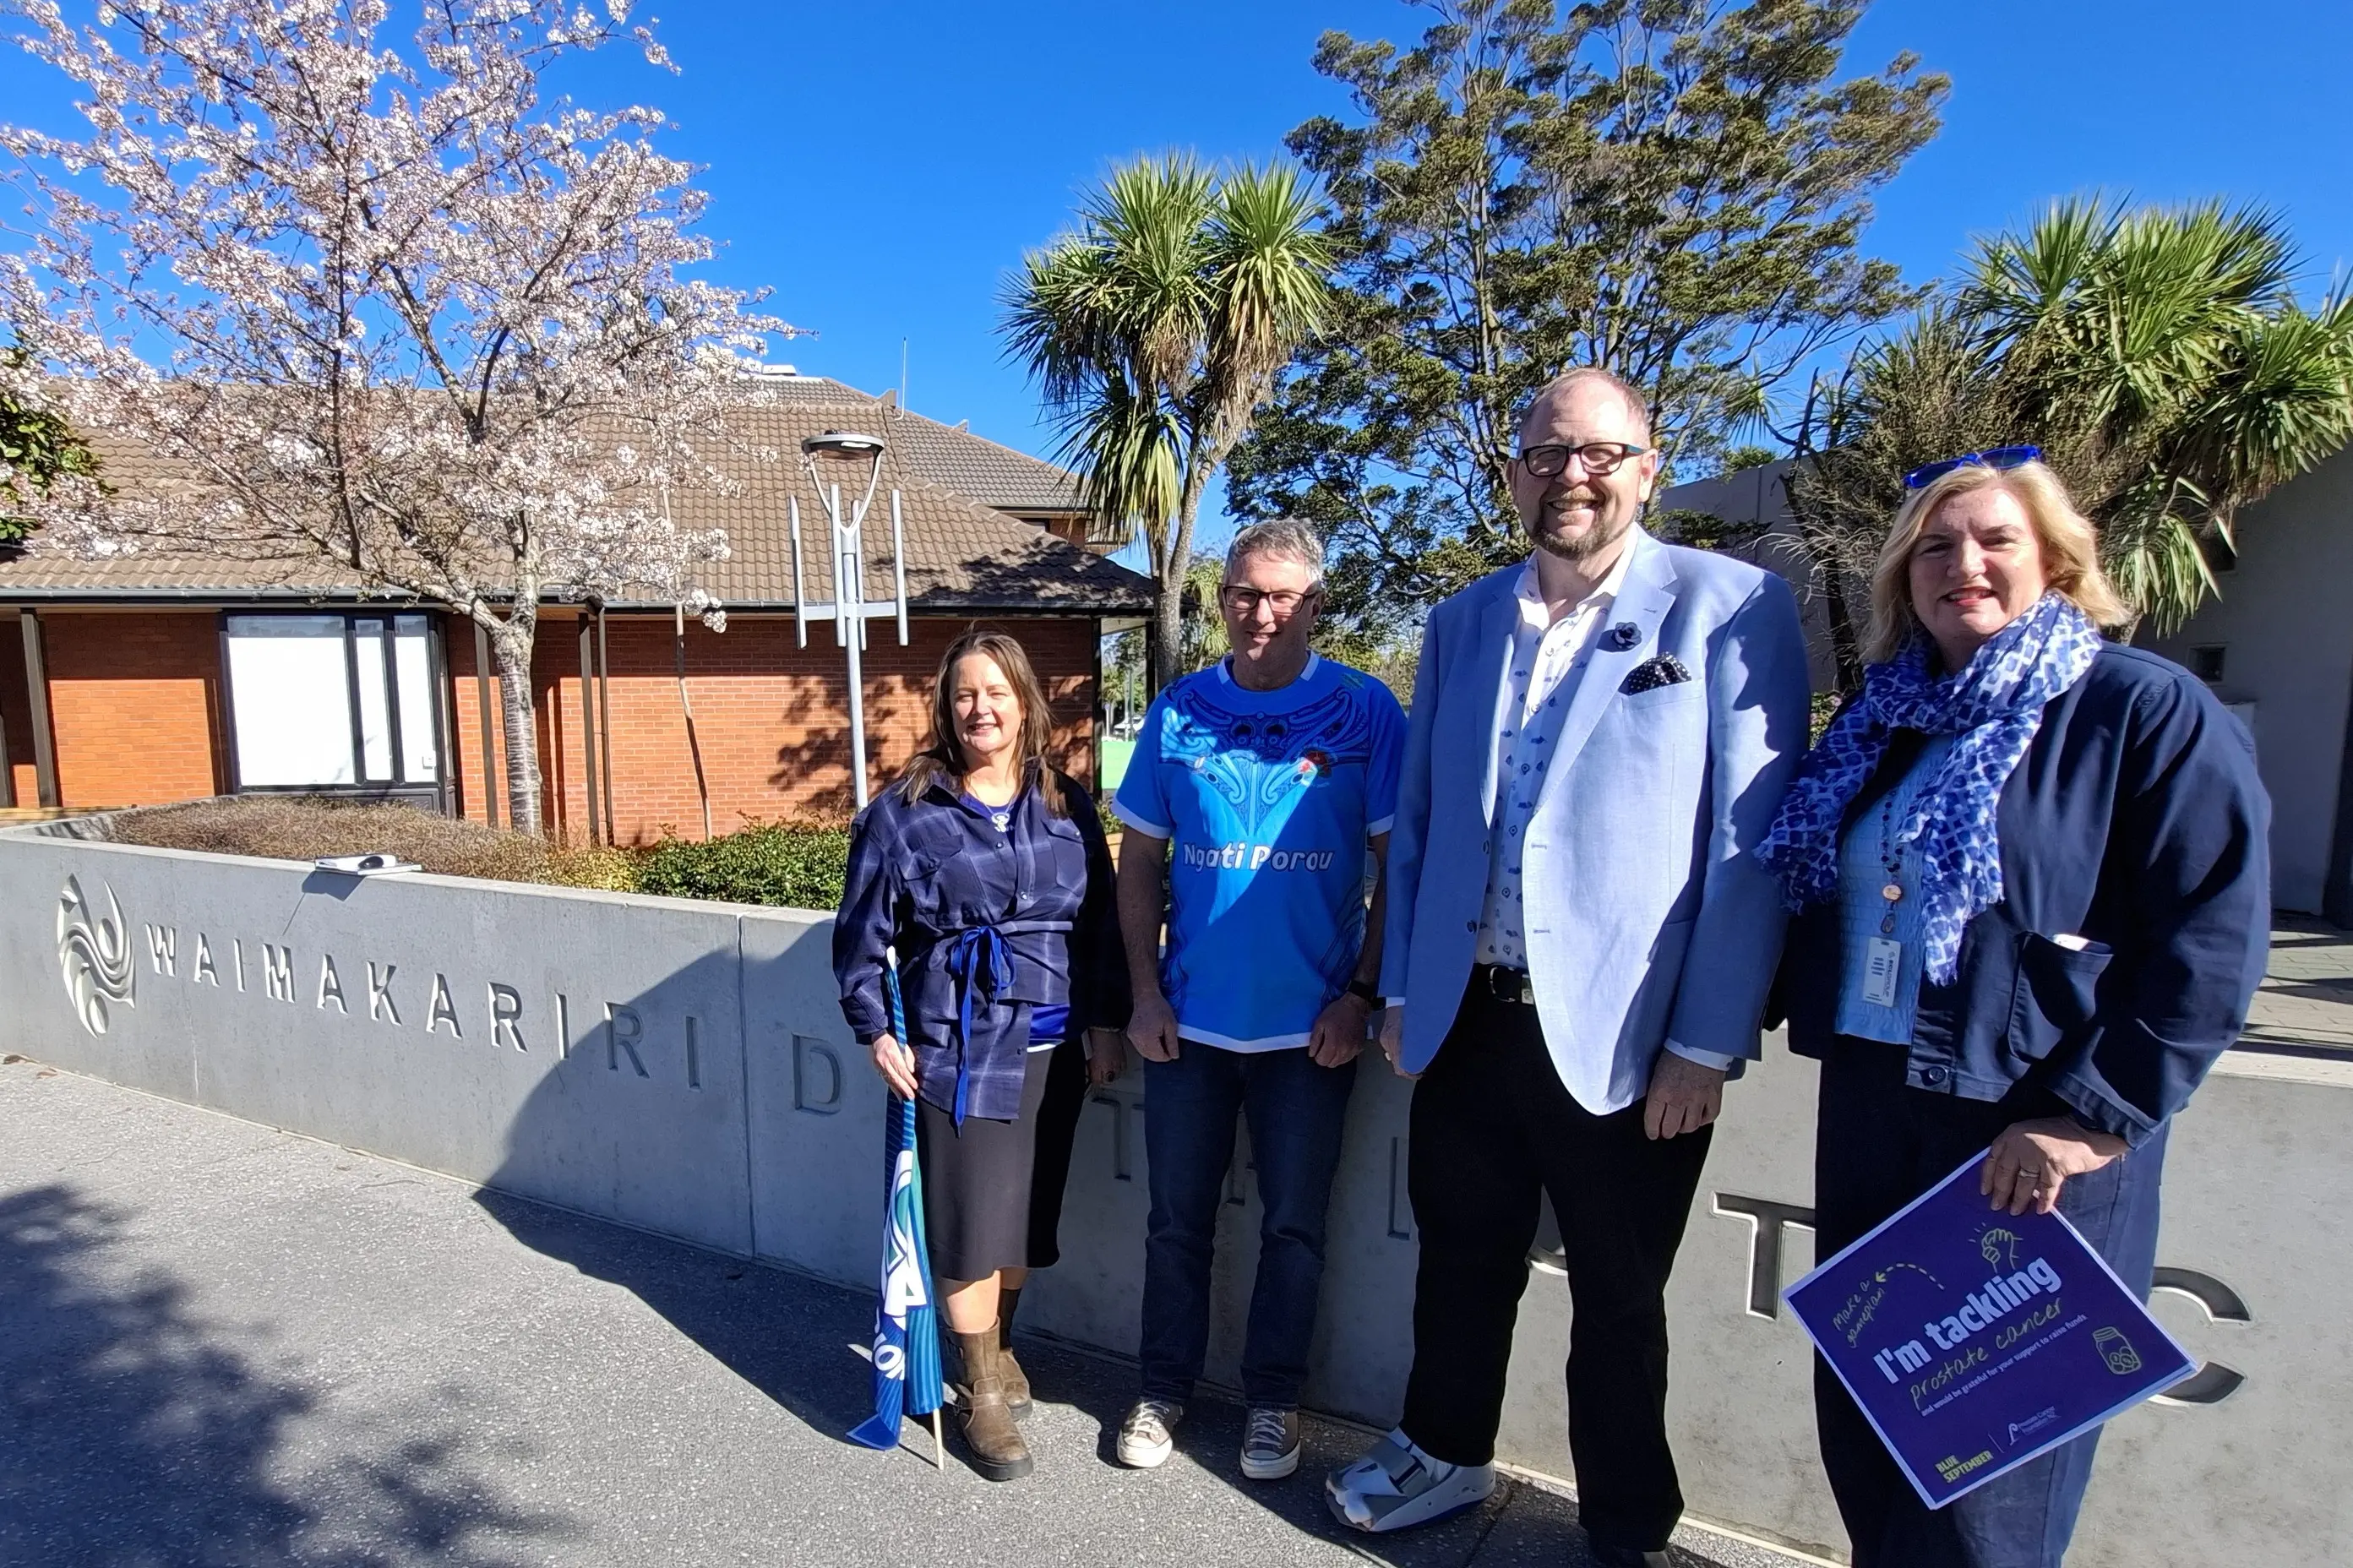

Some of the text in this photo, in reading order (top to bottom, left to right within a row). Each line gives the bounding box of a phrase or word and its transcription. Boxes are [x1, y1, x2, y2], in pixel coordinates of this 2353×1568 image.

[1185, 842, 1334, 873] Ngati Porou
[145, 923, 701, 1089] WAIMAKARIRI
[1832, 1279, 1871, 1331] Make a
[1847, 1288, 1885, 1349] gameplan
[1873, 1257, 2062, 1384] I'm tackling
[1909, 1298, 2062, 1412] prostate cancer
[1952, 1389, 1963, 1399] be
[1961, 1371, 1989, 1394] grateful
[1986, 1366, 1998, 1377] for
[1997, 1357, 2015, 1373] your
[2013, 1342, 2041, 1363] support
[2040, 1337, 2050, 1346] to
[2048, 1326, 2067, 1341] raise
[2065, 1313, 2089, 1330] funds
[1935, 1454, 1960, 1474] BLUE
[1942, 1450, 1995, 1484] SEPTEMBER
